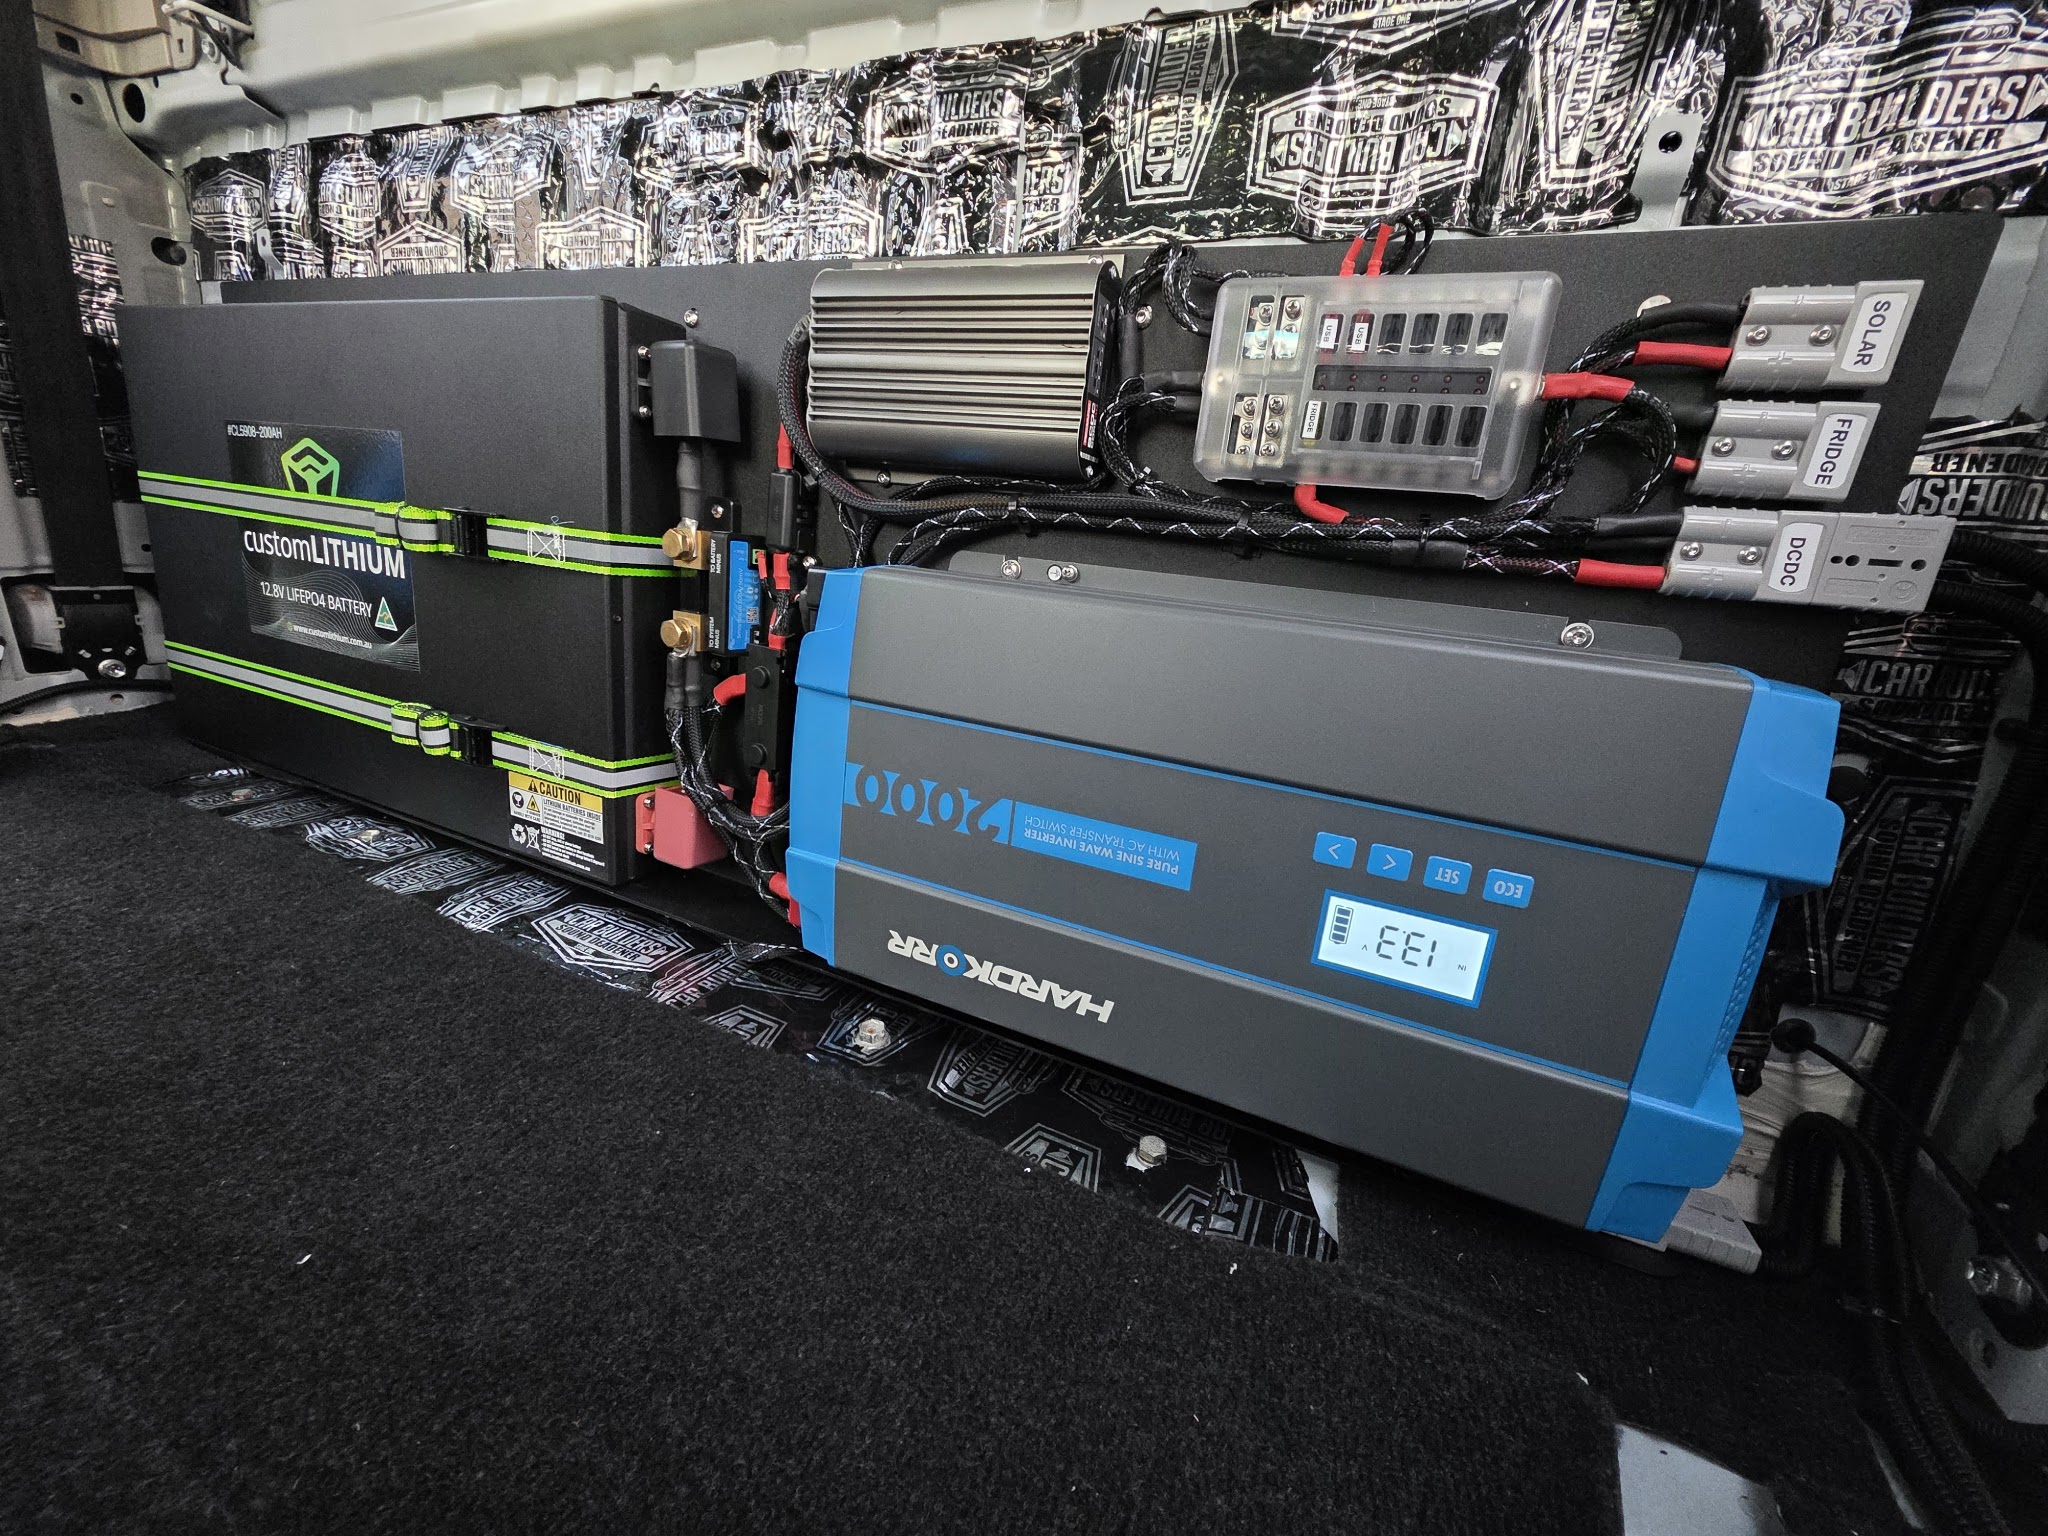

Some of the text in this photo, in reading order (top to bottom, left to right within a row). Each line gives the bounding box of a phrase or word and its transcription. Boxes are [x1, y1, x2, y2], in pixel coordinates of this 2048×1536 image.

[1389, 97, 1452, 132] SOUND
[1758, 73, 2028, 149] CAR BUILDERS
[1289, 120, 1447, 174] CAR BUILDERS
[1322, 323, 1335, 344] USB
[1352, 325, 1366, 347] USB
[1853, 299, 1892, 366] SOLAR
[1304, 402, 1320, 434] FRIDGE
[1813, 418, 1853, 486] FRIDGE
[243, 530, 406, 579] customLITHIUM
[1779, 536, 1807, 587] DCDC
[260, 581, 373, 618] 12.8V LIFEPO4 BATTERY
[293, 624, 373, 650] www.customlithium.com.au
[1862, 659, 1934, 699] CAR
[539, 781, 581, 806] CAUTION
[543, 798, 602, 822] LITHIUM BATTERIES INSIDE
[855, 764, 1003, 844] 2000
[1023, 827, 1179, 876] PURE SINE WAVE INVERTER
[1024, 814, 1181, 863] WITH AC TRANSFER SWITCH
[1434, 866, 1461, 885] SET
[1493, 880, 1524, 900] ECO
[554, 923, 589, 942] SOUND
[586, 933, 643, 961] DEADENER
[569, 911, 599, 932] CAR
[597, 922, 665, 957] BUILDERS
[1375, 924, 1438, 968] 13.3
